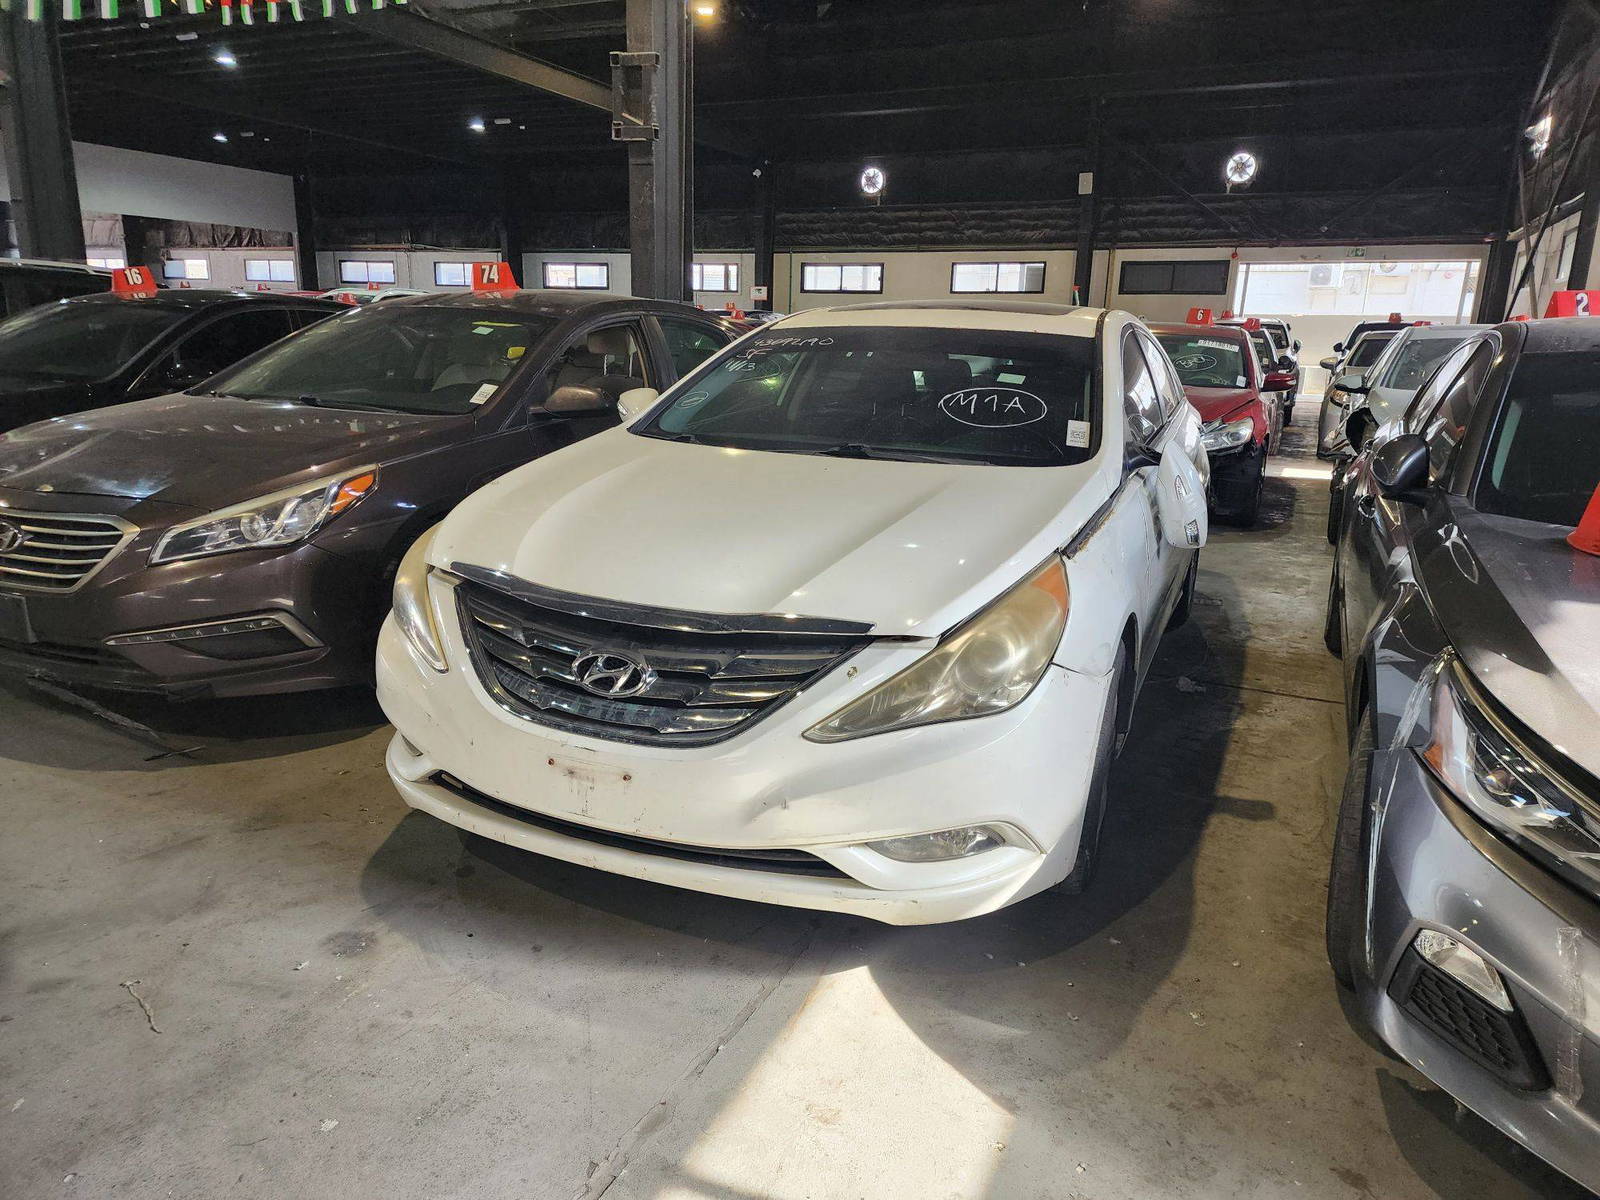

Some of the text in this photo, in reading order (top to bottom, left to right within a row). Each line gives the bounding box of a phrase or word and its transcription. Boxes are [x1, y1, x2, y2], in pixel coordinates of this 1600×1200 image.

[124, 268, 143, 285] 16
[481, 264, 499, 284] 74
[1576, 292, 1590, 316] 2
[1197, 309, 1204, 321] 6
